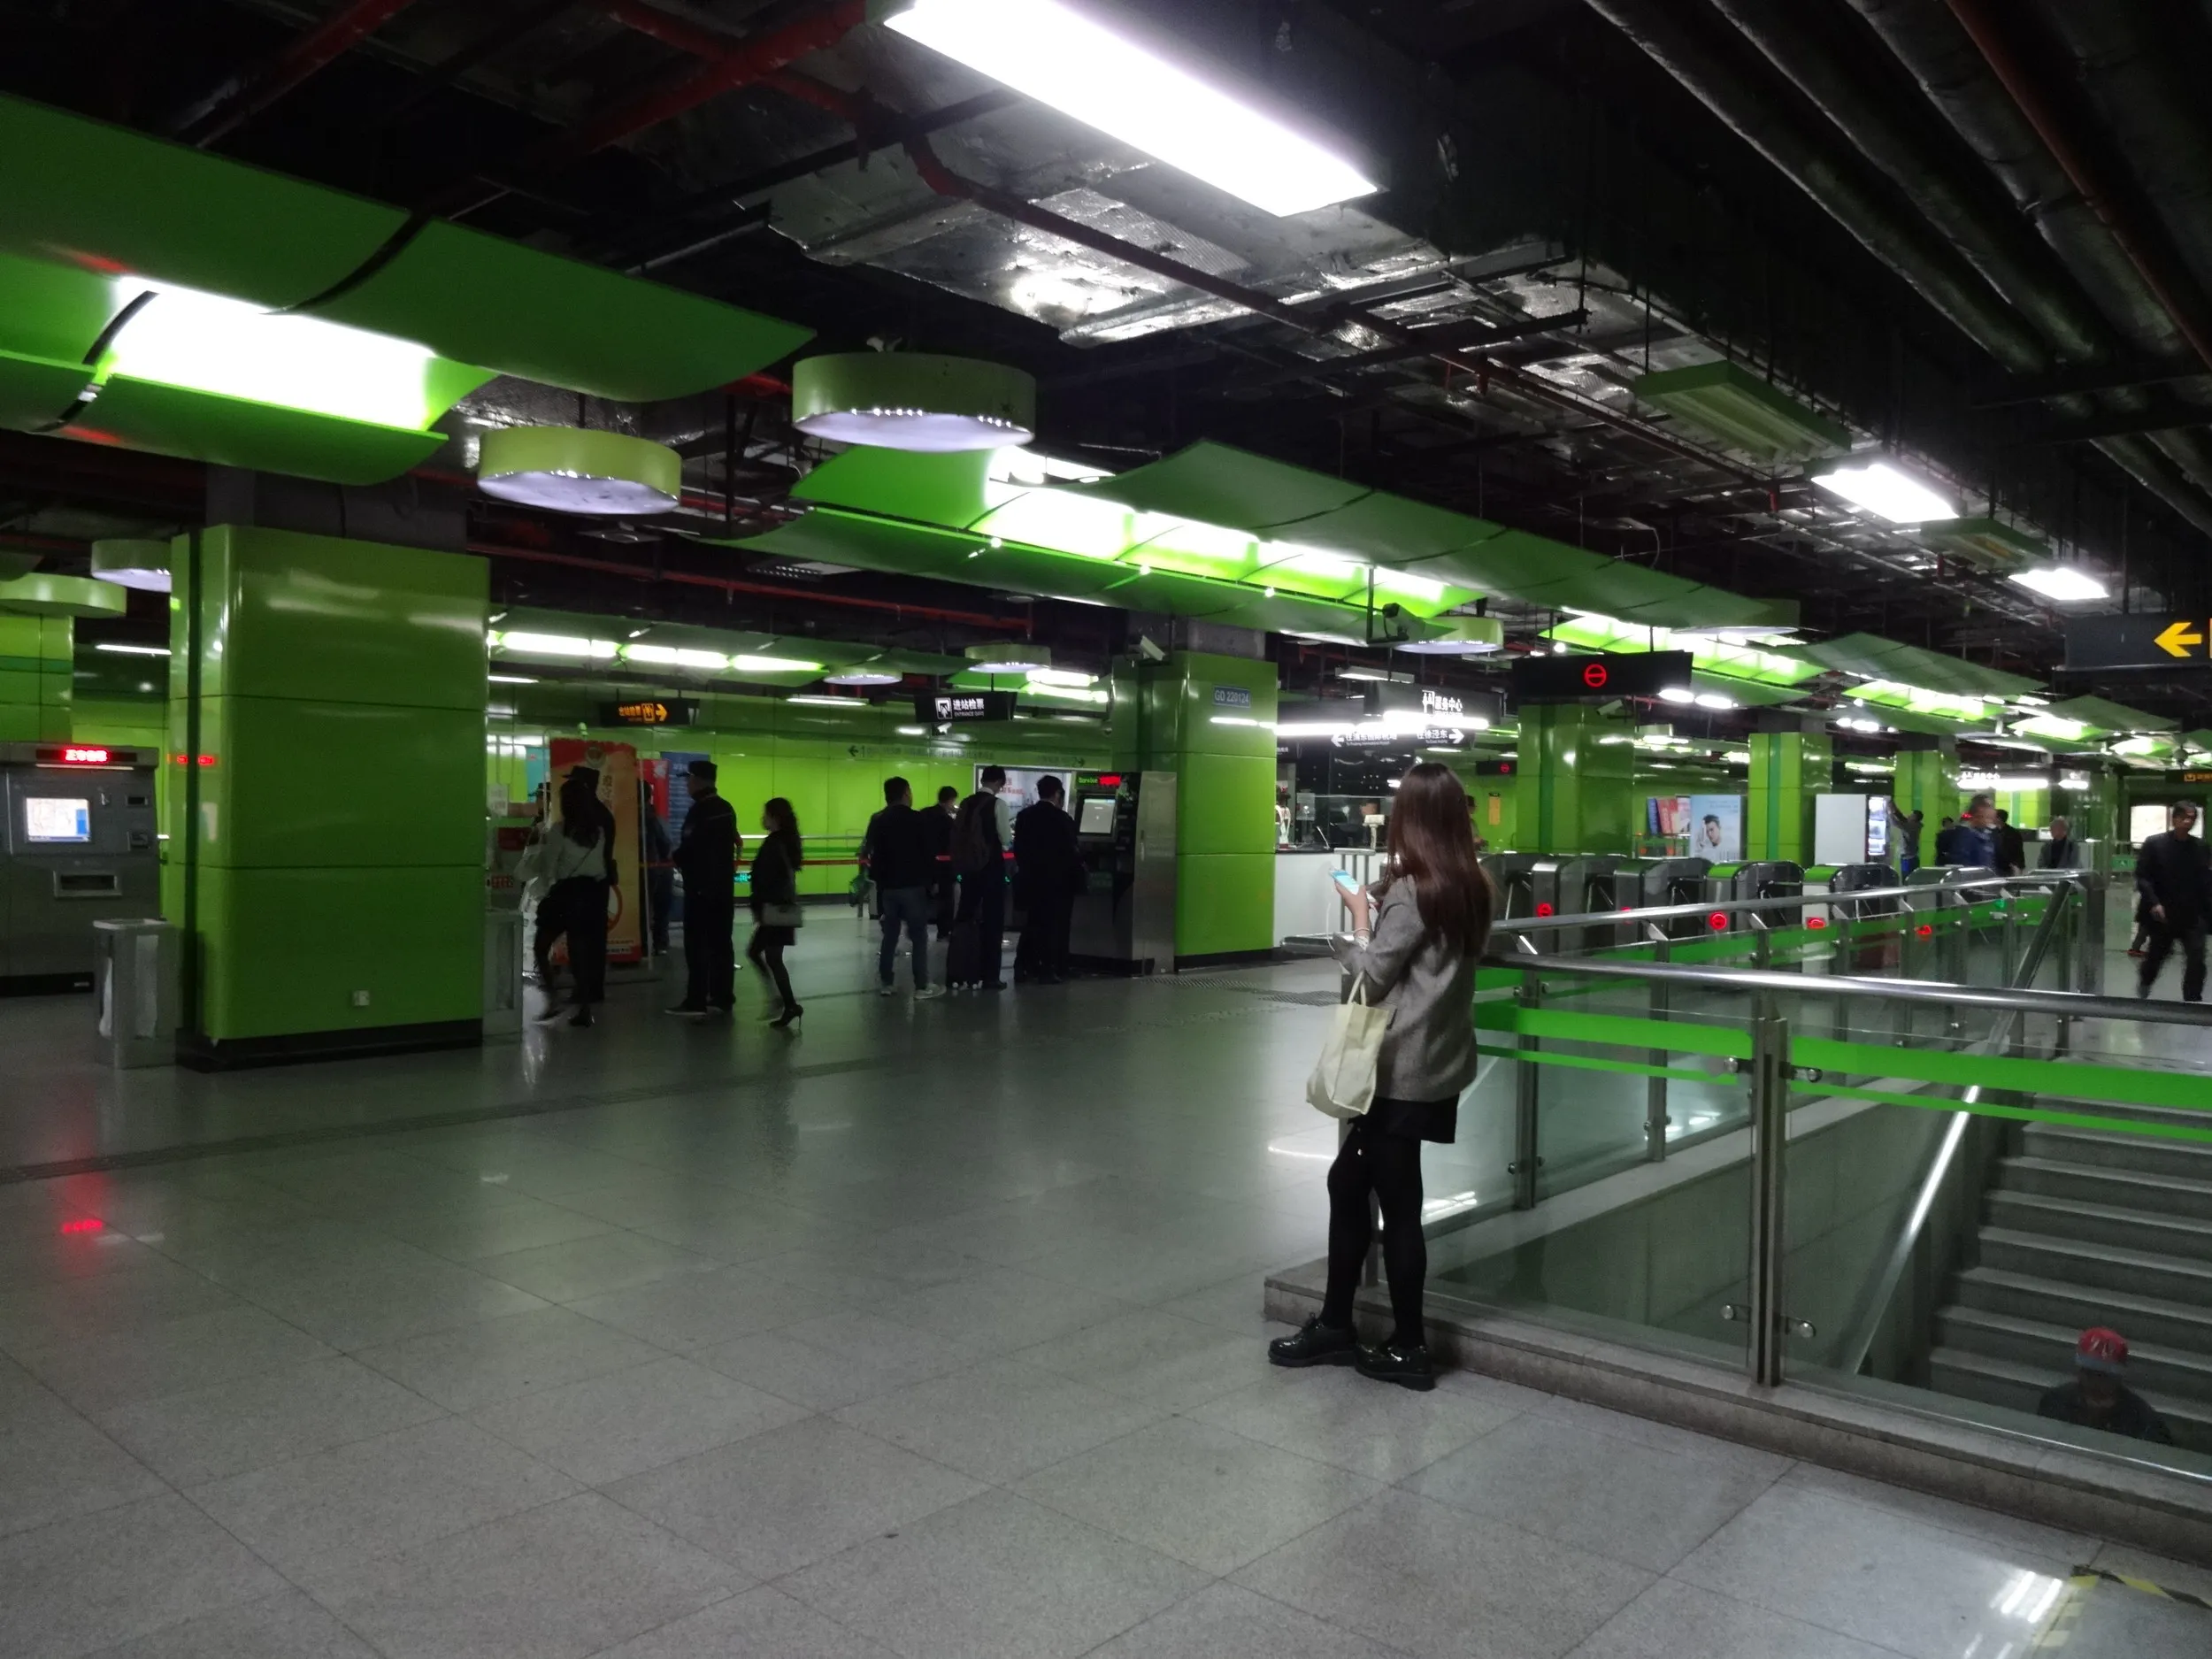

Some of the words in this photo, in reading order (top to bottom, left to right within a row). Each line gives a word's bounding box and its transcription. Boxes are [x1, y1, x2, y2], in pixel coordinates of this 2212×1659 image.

[1215, 690, 1225, 702] GD
[953, 698, 984, 710] 进站检票
[1435, 696, 1463, 712] 服务中心
